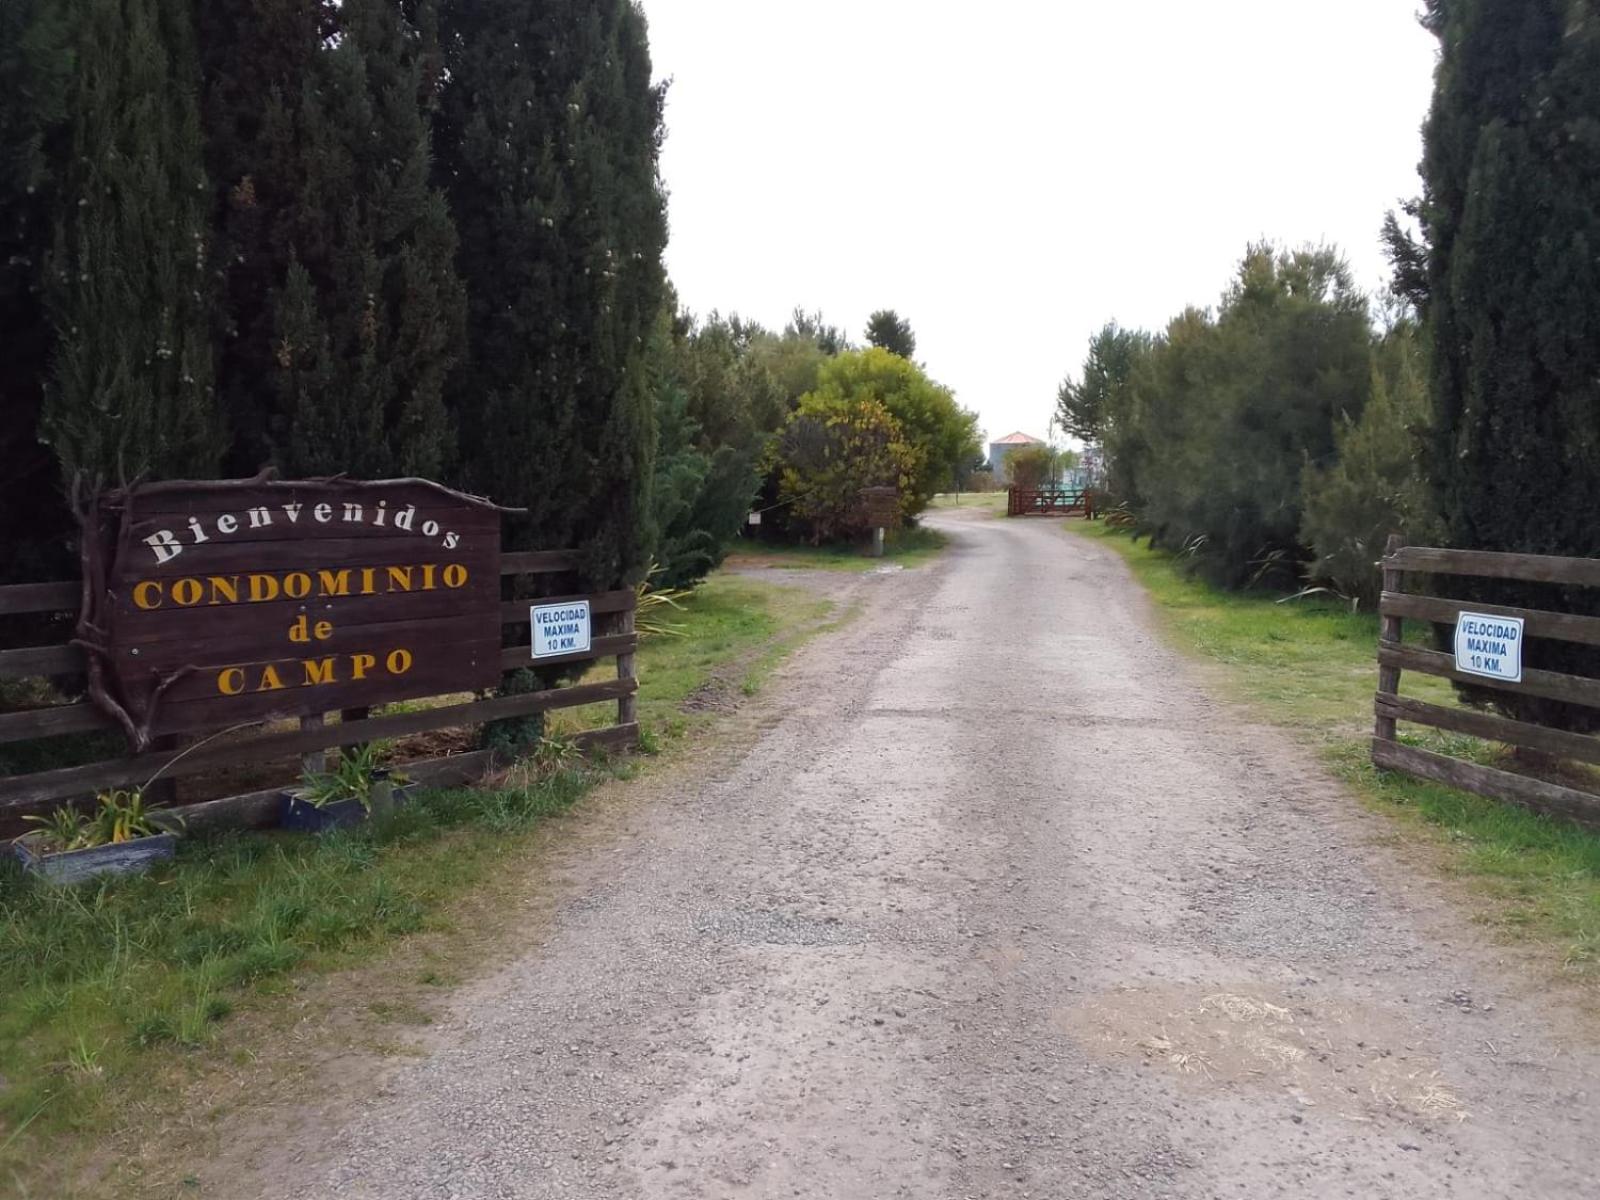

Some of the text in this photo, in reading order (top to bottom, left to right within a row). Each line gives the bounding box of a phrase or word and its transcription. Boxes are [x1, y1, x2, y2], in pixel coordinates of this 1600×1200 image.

[142, 499, 460, 564] Bienvenidos
[133, 563, 468, 610] CONDOMINIO
[536, 609, 585, 624] VELOCIDAD
[288, 615, 333, 642] de
[544, 623, 579, 637] MAXIMA
[1462, 620, 1517, 640] VELOCIDAD
[548, 640, 558, 650] 10
[1467, 638, 1507, 656] MAXIMA
[217, 649, 413, 695] CAMPO
[1470, 655, 1502, 673] 10 KM.
